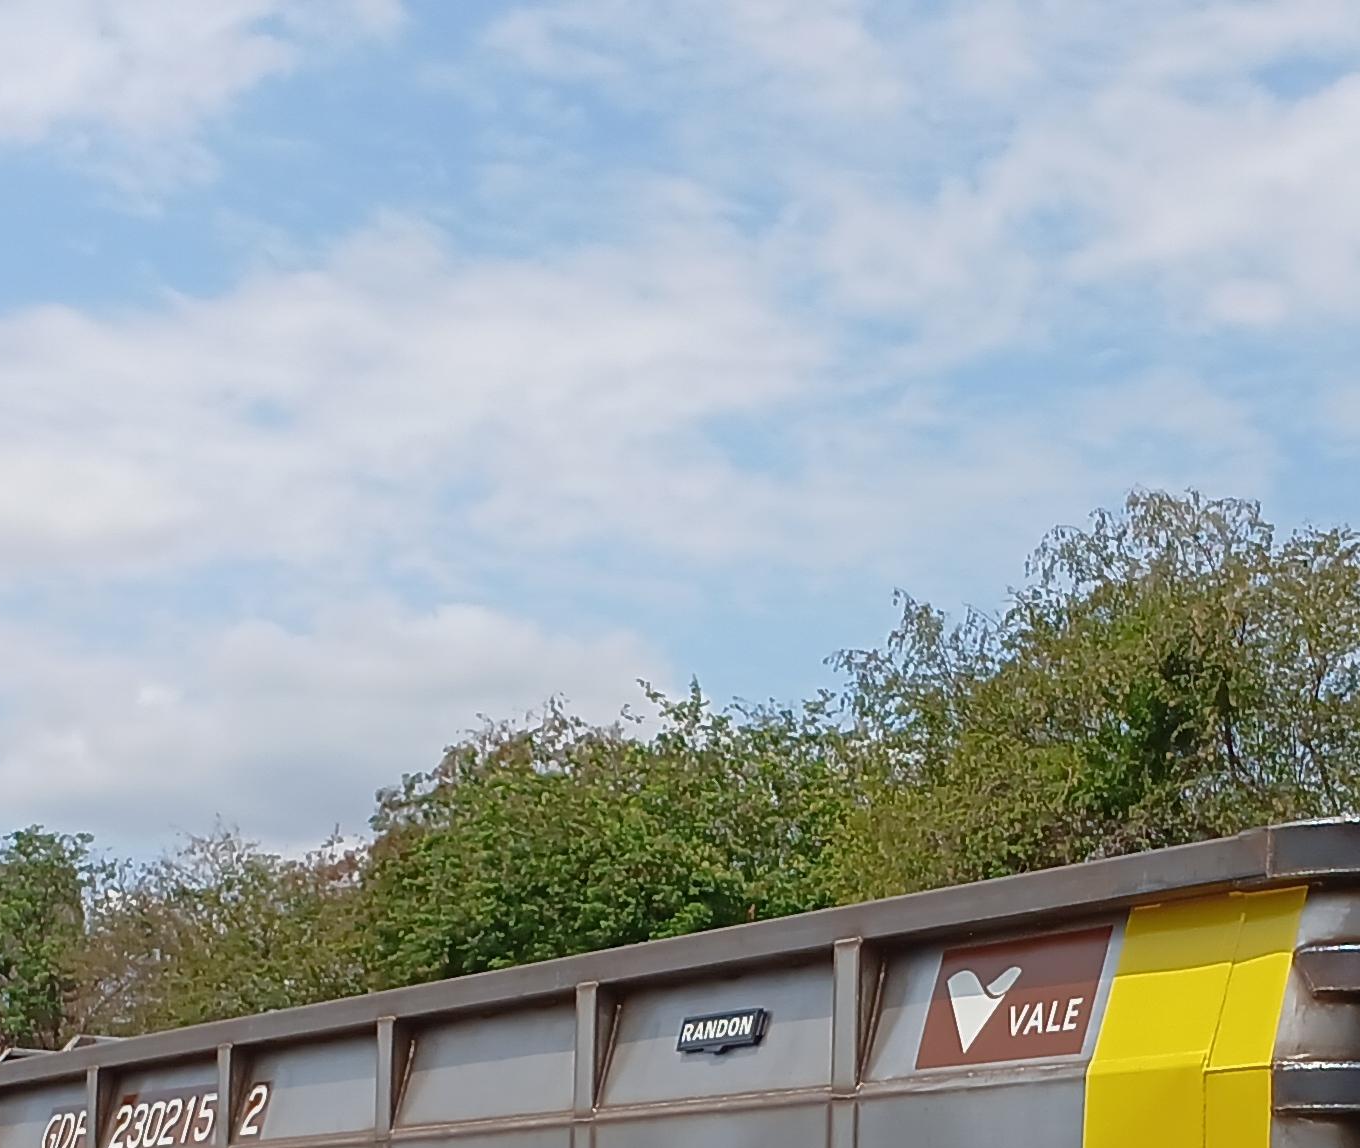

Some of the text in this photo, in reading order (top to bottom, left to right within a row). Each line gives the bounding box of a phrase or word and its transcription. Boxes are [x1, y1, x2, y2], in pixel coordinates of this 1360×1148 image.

[681, 1015, 754, 1042] RANDON
[1009, 997, 1083, 1037] VALE
[239, 1085, 268, 1137] 2
